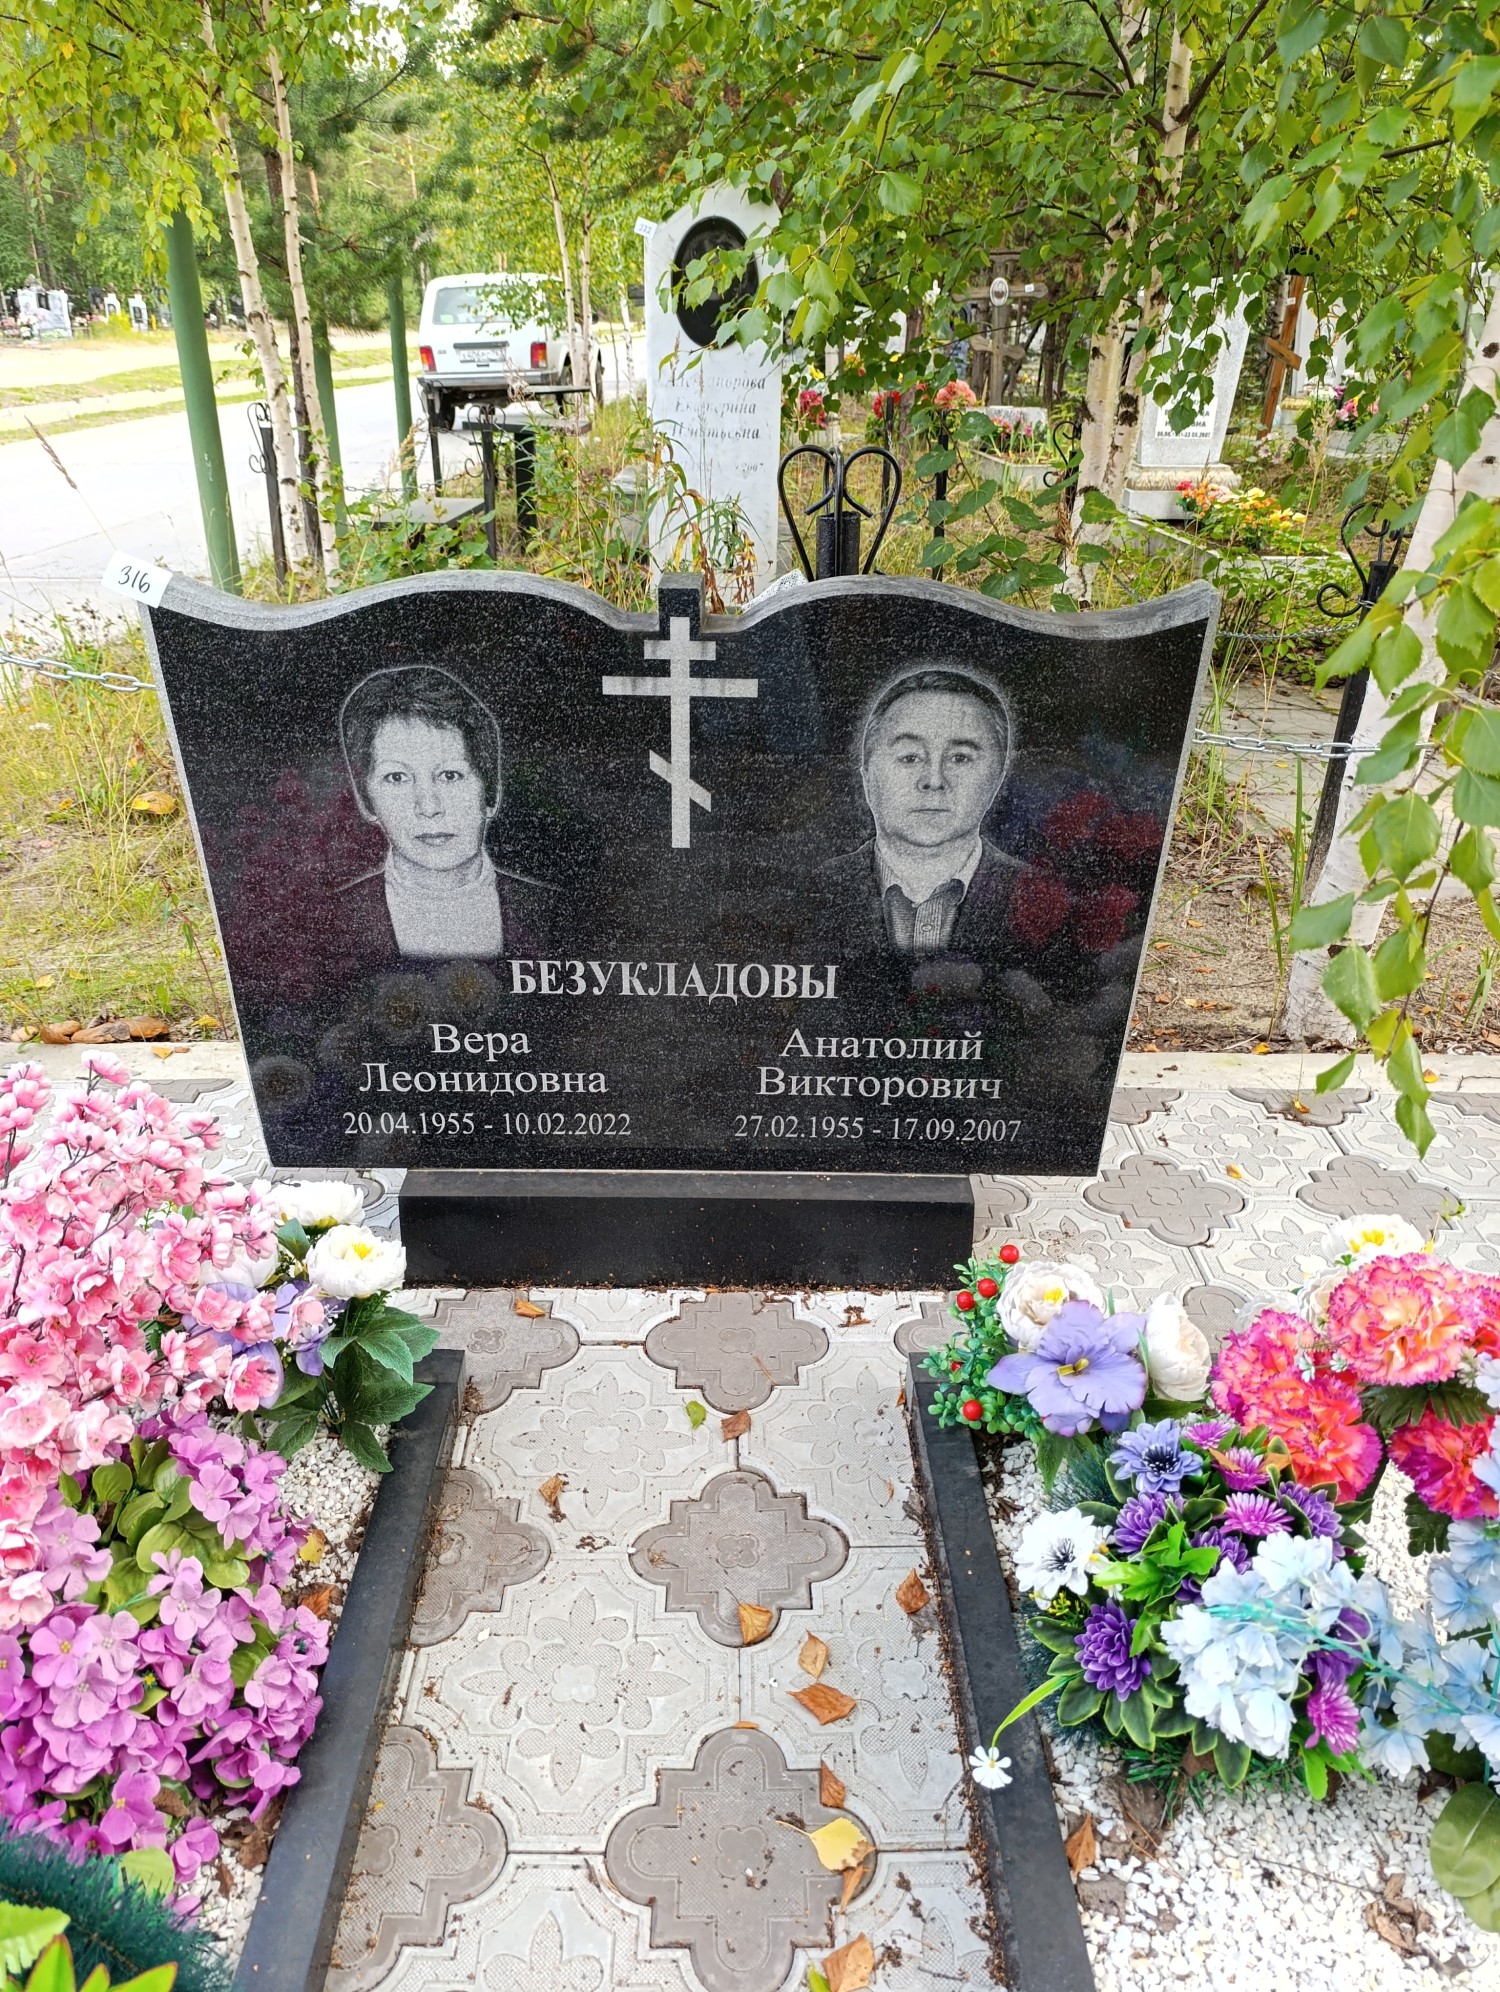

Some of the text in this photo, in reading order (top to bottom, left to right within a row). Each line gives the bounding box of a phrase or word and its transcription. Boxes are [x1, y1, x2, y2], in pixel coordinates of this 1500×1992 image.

[118, 565, 151, 594] 316
[507, 959, 840, 1006] БЕЗУКЛАДОВЫ
[429, 1023, 532, 1062] Вера
[779, 1028, 984, 1060] Анатолий
[359, 1062, 609, 1097] Леонидовна
[755, 1066, 1003, 1105] Викторович
[342, 1111, 475, 1135] 20.04.1955
[502, 1112, 632, 1136] 10.02.2022
[734, 1115, 864, 1138] 27.02.1955
[891, 1118, 1022, 1141] 17.09.2007
